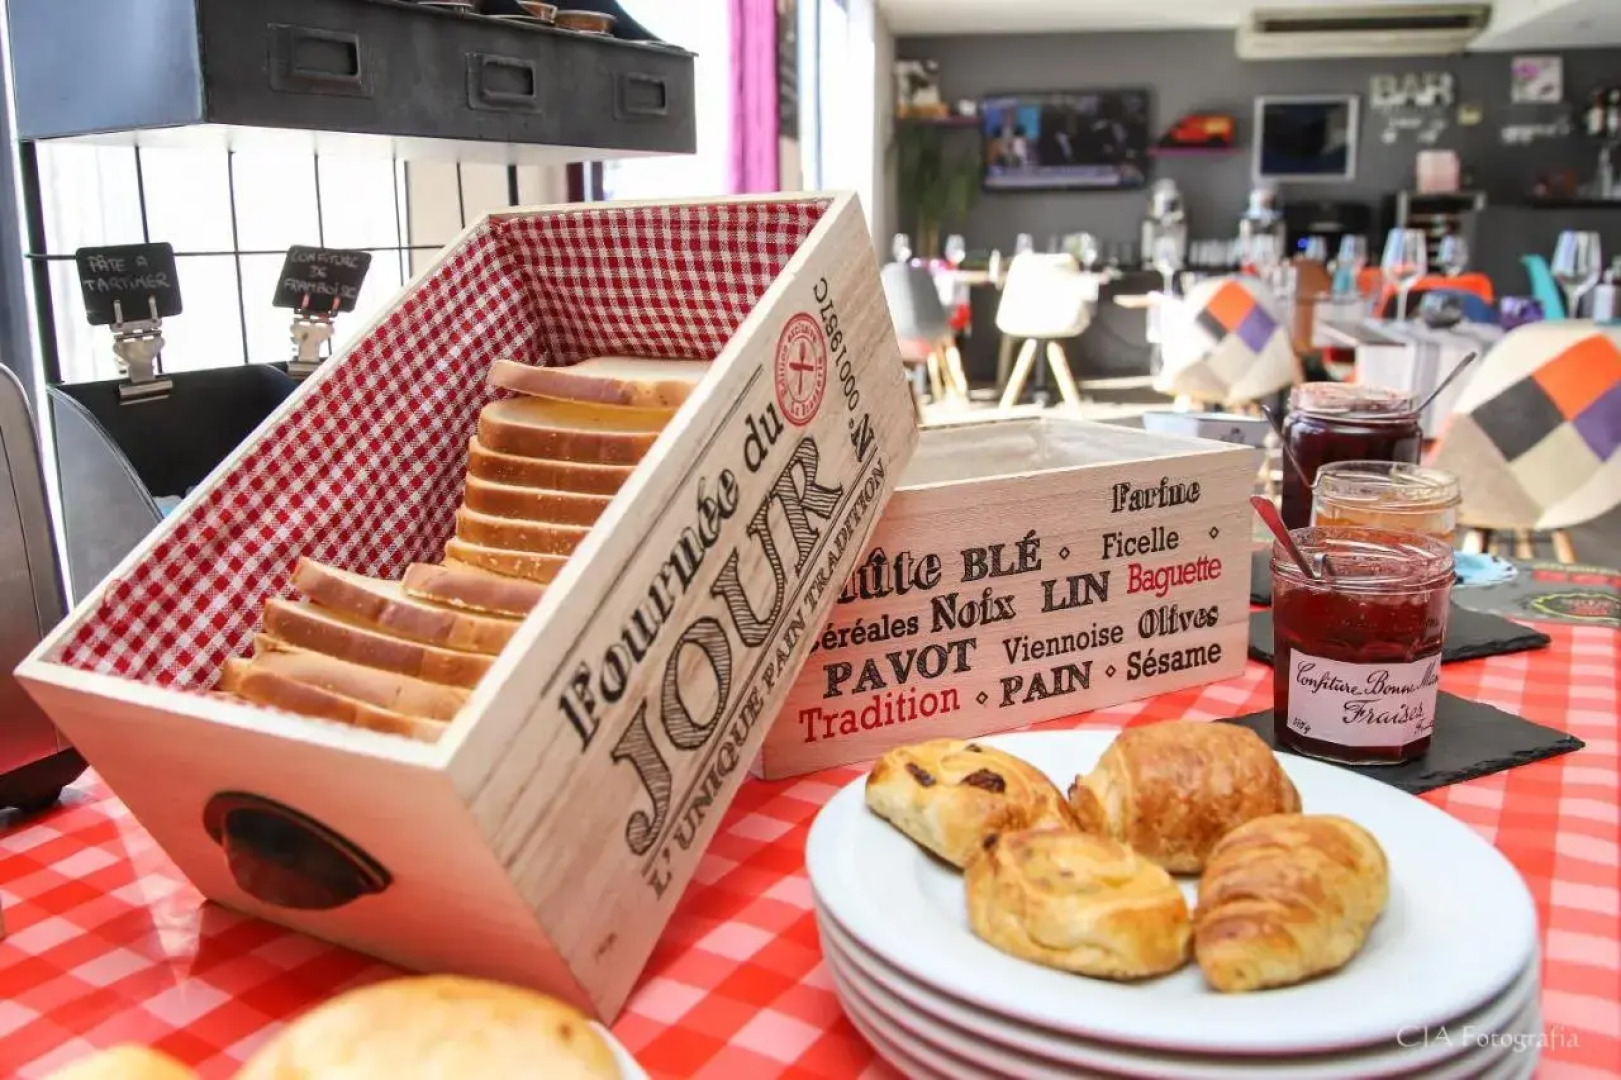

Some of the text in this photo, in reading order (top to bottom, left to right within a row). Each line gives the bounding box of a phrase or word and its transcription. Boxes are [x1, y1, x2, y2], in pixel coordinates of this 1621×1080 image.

[1111, 476, 1200, 513] Farine
[558, 402, 784, 753] Fournée du
[761, 610, 807, 694] PAIN
[803, 457, 886, 612] TRADITION
[810, 555, 1222, 653] éréales Noix LIN Baguette
[838, 526, 1179, 604] lûte BLÉ Ficelle
[610, 436, 844, 856] JOUR
[799, 640, 1222, 743] Tradition PAIN Sésame
[822, 603, 1219, 699] PAVOT Viennoise Olives
[1296, 661, 1362, 695] Confiture
[1342, 699, 1423, 725] Fraises
